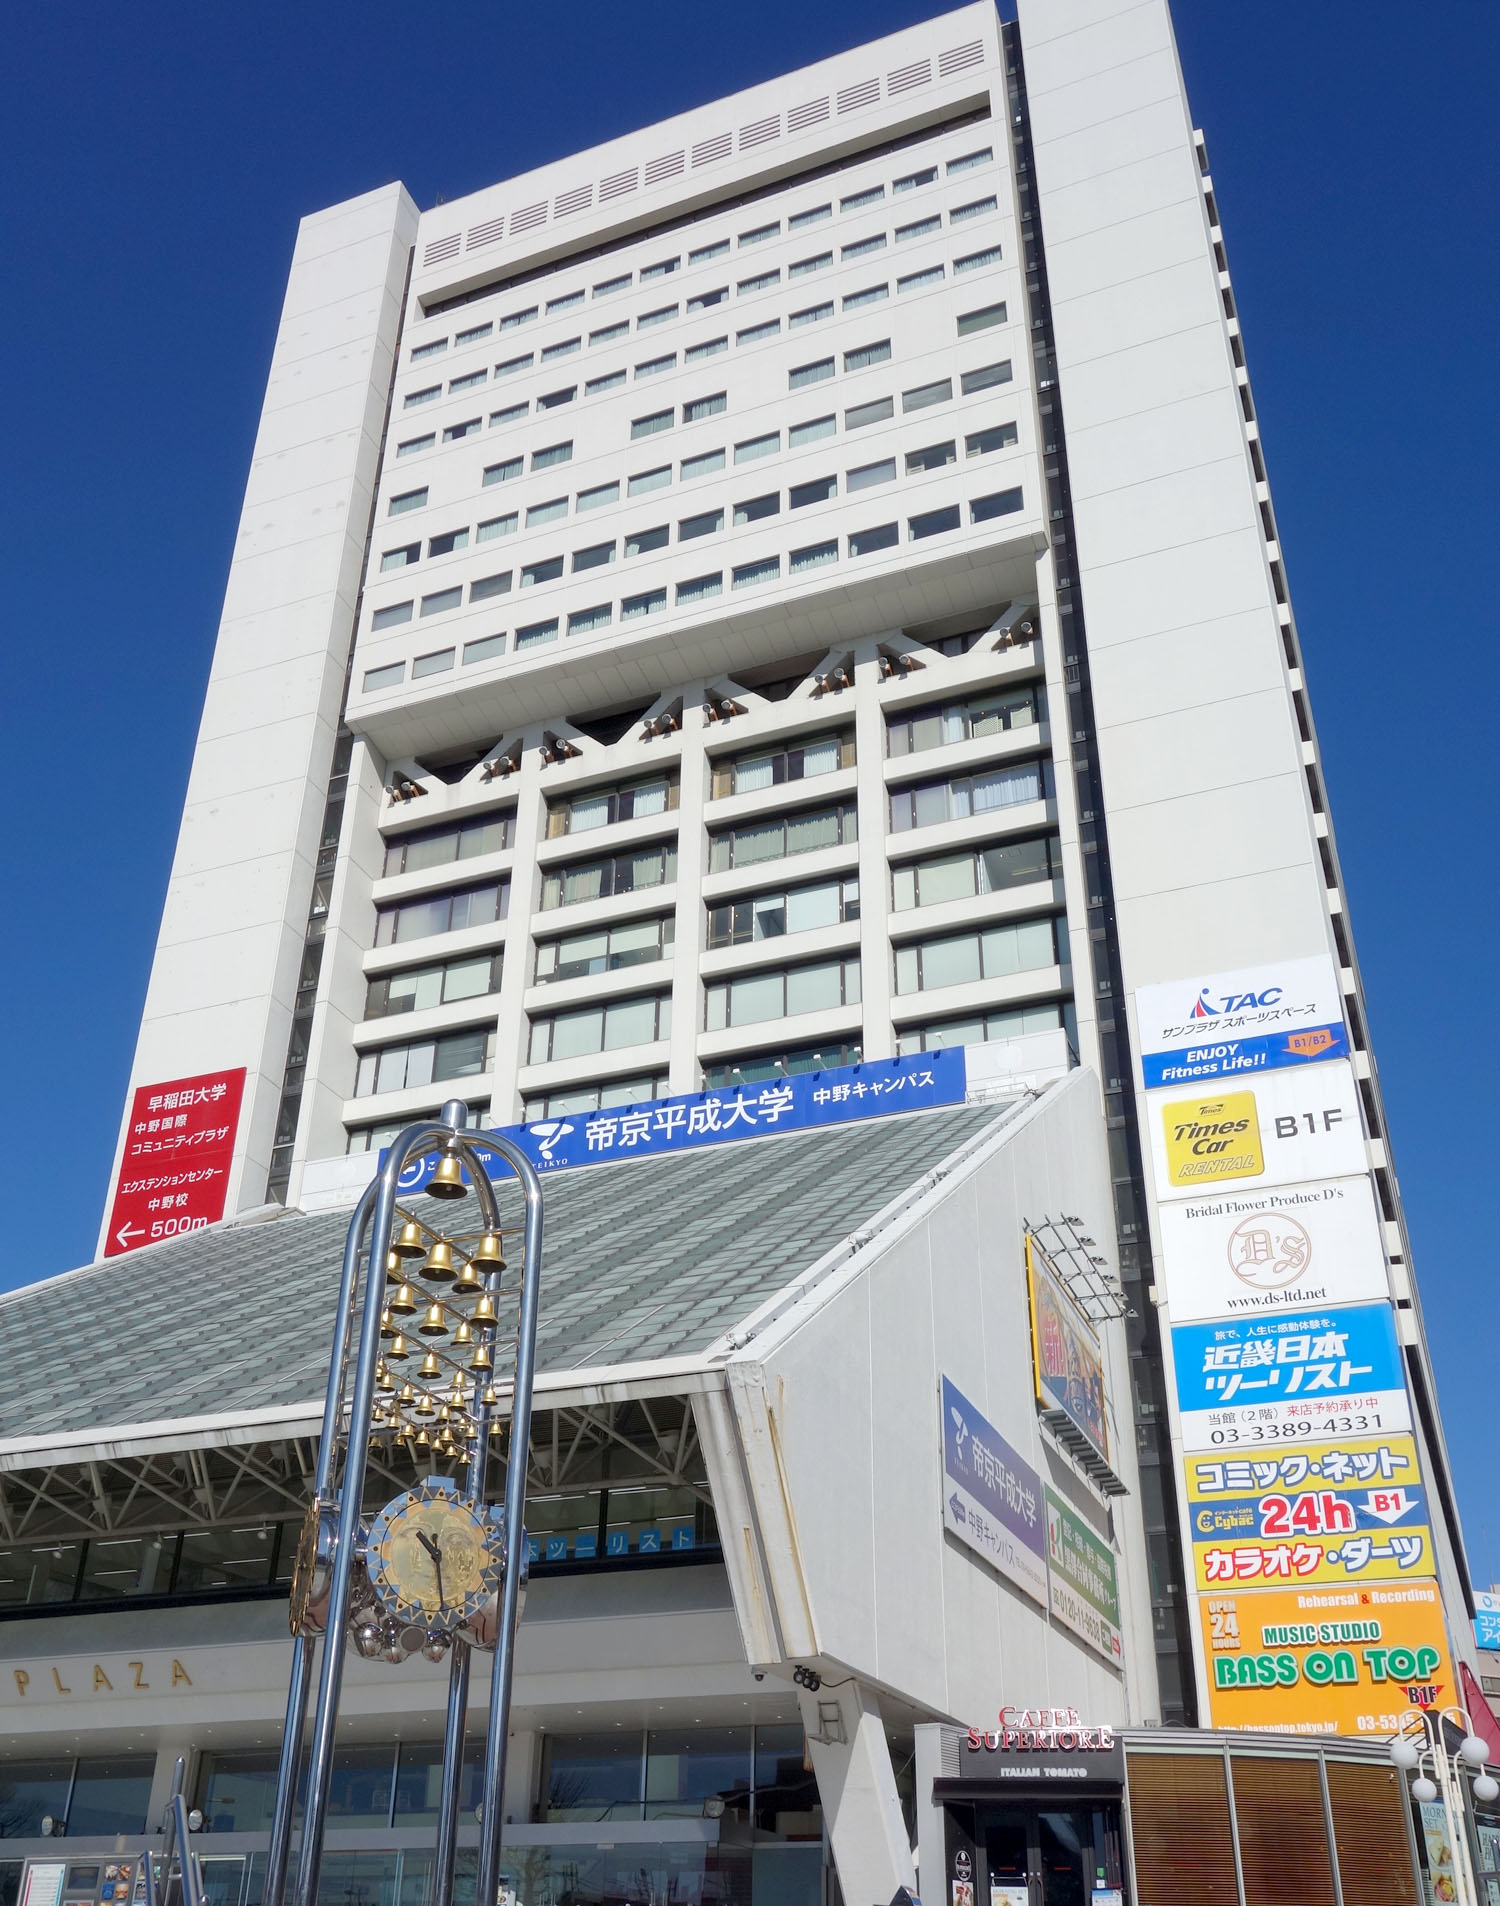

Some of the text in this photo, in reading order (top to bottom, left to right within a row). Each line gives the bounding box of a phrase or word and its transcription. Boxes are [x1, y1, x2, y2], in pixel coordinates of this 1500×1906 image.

[1220, 987, 1283, 1013] TAC
[1162, 1003, 1316, 1039] サンプラザ スポーツスペース
[1187, 1044, 1239, 1063] ENJOY
[1294, 1035, 1327, 1048] B1/B2
[1162, 1053, 1266, 1080] Fitness Life!!
[147, 1083, 226, 1113] 早稲田大学
[585, 1070, 935, 1151] 帝京平成大学 中野キャンパス
[1200, 1103, 1224, 1115] Times
[135, 1114, 188, 1135] 中野国際
[1174, 1118, 1249, 1141] Times
[1275, 1108, 1343, 1139] B1F
[131, 1126, 229, 1155] コミュニティプラザ
[1192, 1138, 1234, 1155] Car
[1178, 1154, 1255, 1178] RENTAL
[121, 1168, 223, 1194] エクステンションセンター
[148, 1193, 189, 1211] 中野校
[1185, 1188, 1344, 1219] Bridal Flower Produce D's
[151, 1216, 207, 1237] 500m
[1227, 1287, 1327, 1309] www.ds-ltd.net
[1214, 1318, 1338, 1341] 旅で、人生に感動体験を。
[1203, 1330, 1349, 1373] 近畿日本
[1205, 1361, 1373, 1401] ツーリスト
[1286, 1397, 1379, 1418] 来店予約承り中
[1210, 1414, 1383, 1445] 03-3389-4331
[971, 1435, 1037, 1528] 帝京平成大学
[1196, 1447, 1410, 1492] コミック・ネット
[1259, 1491, 1402, 1537] 24h B1
[968, 1511, 1015, 1568] 中野キャンパス
[1205, 1535, 1423, 1581] カラオケ・ダーツ
[1208, 1600, 1236, 1613] OPEN
[1298, 1590, 1434, 1608] Rehearsal & Recording
[1211, 1613, 1239, 1638] 24
[1264, 1621, 1381, 1644] MUSIC STUDIO
[1213, 1638, 1240, 1649] HOURS
[13, 1659, 193, 1697] PLAZA
[1214, 1655, 1299, 1687] BASS
[1364, 1647, 1440, 1682] TOP
[1408, 1685, 1437, 1704] B1F
[968, 1725, 1114, 1749] SUPERIORE
[1001, 1768, 1088, 1777] ITALIAN TOMATO
